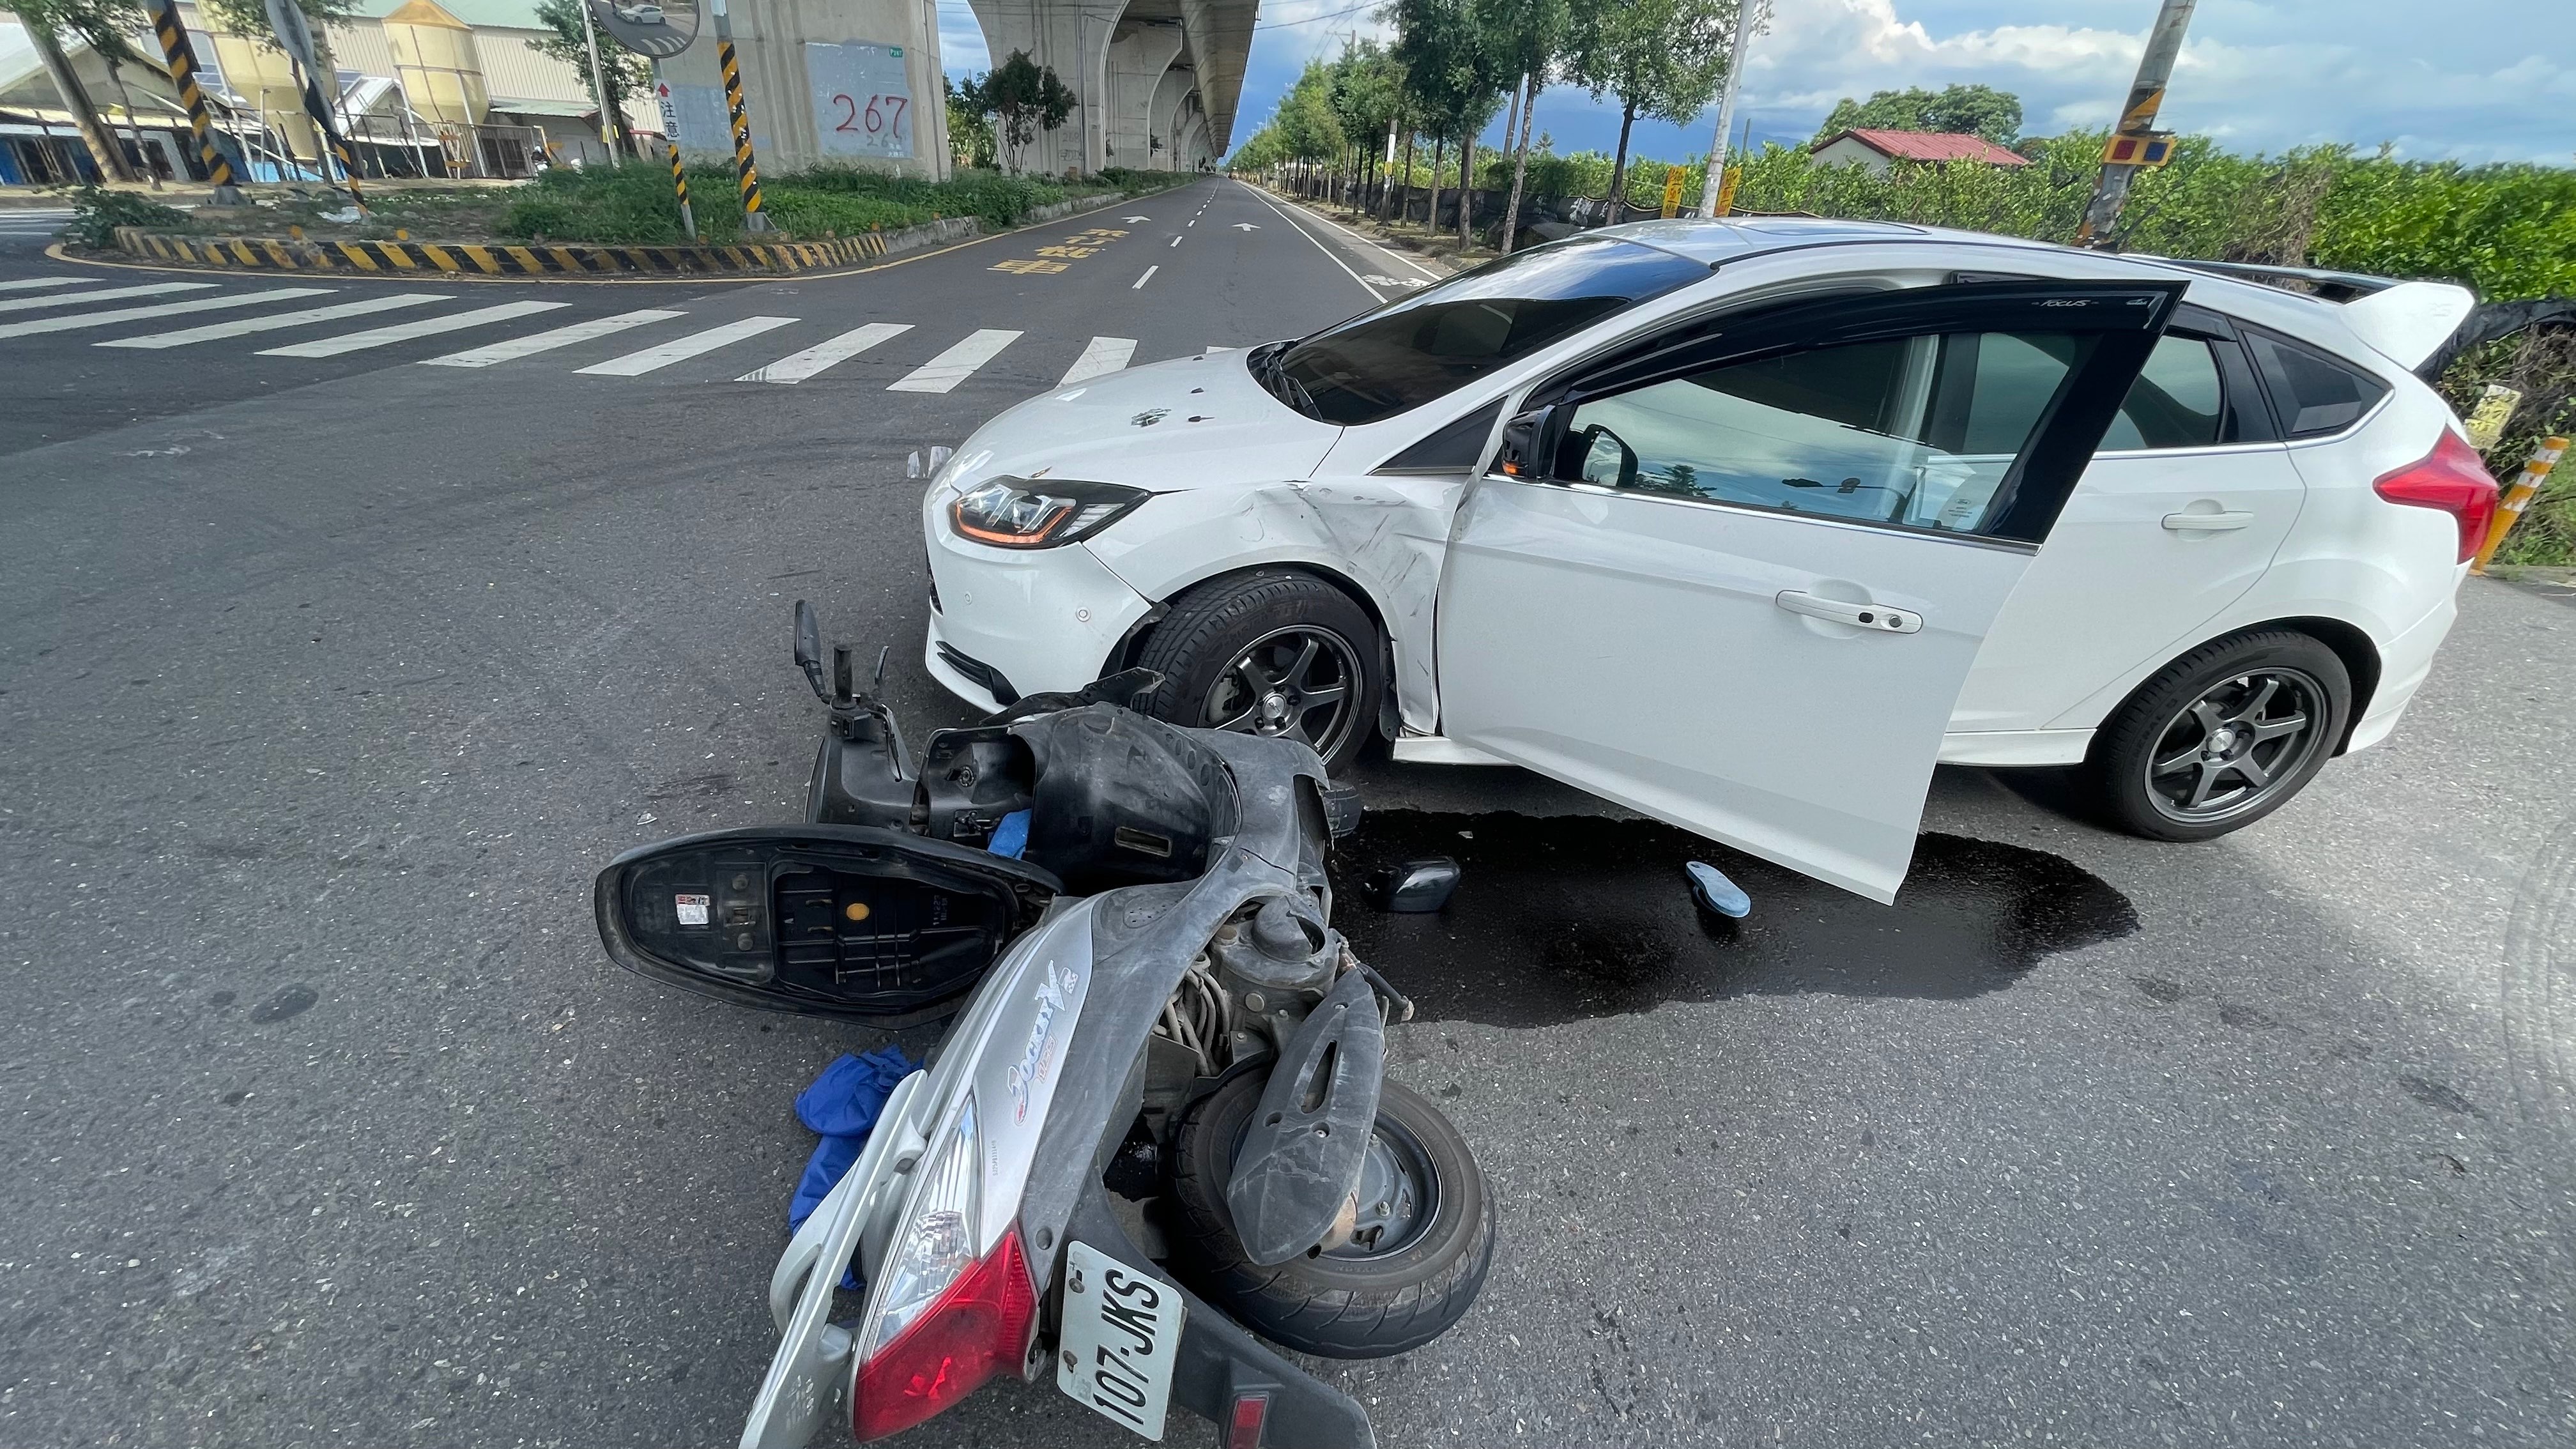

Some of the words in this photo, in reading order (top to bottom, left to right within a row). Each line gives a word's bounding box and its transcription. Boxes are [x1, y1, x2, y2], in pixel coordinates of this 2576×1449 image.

[661, 101, 680, 137] 注意
[833, 94, 908, 138] 267
[1038, 1034, 1057, 1084] 125
